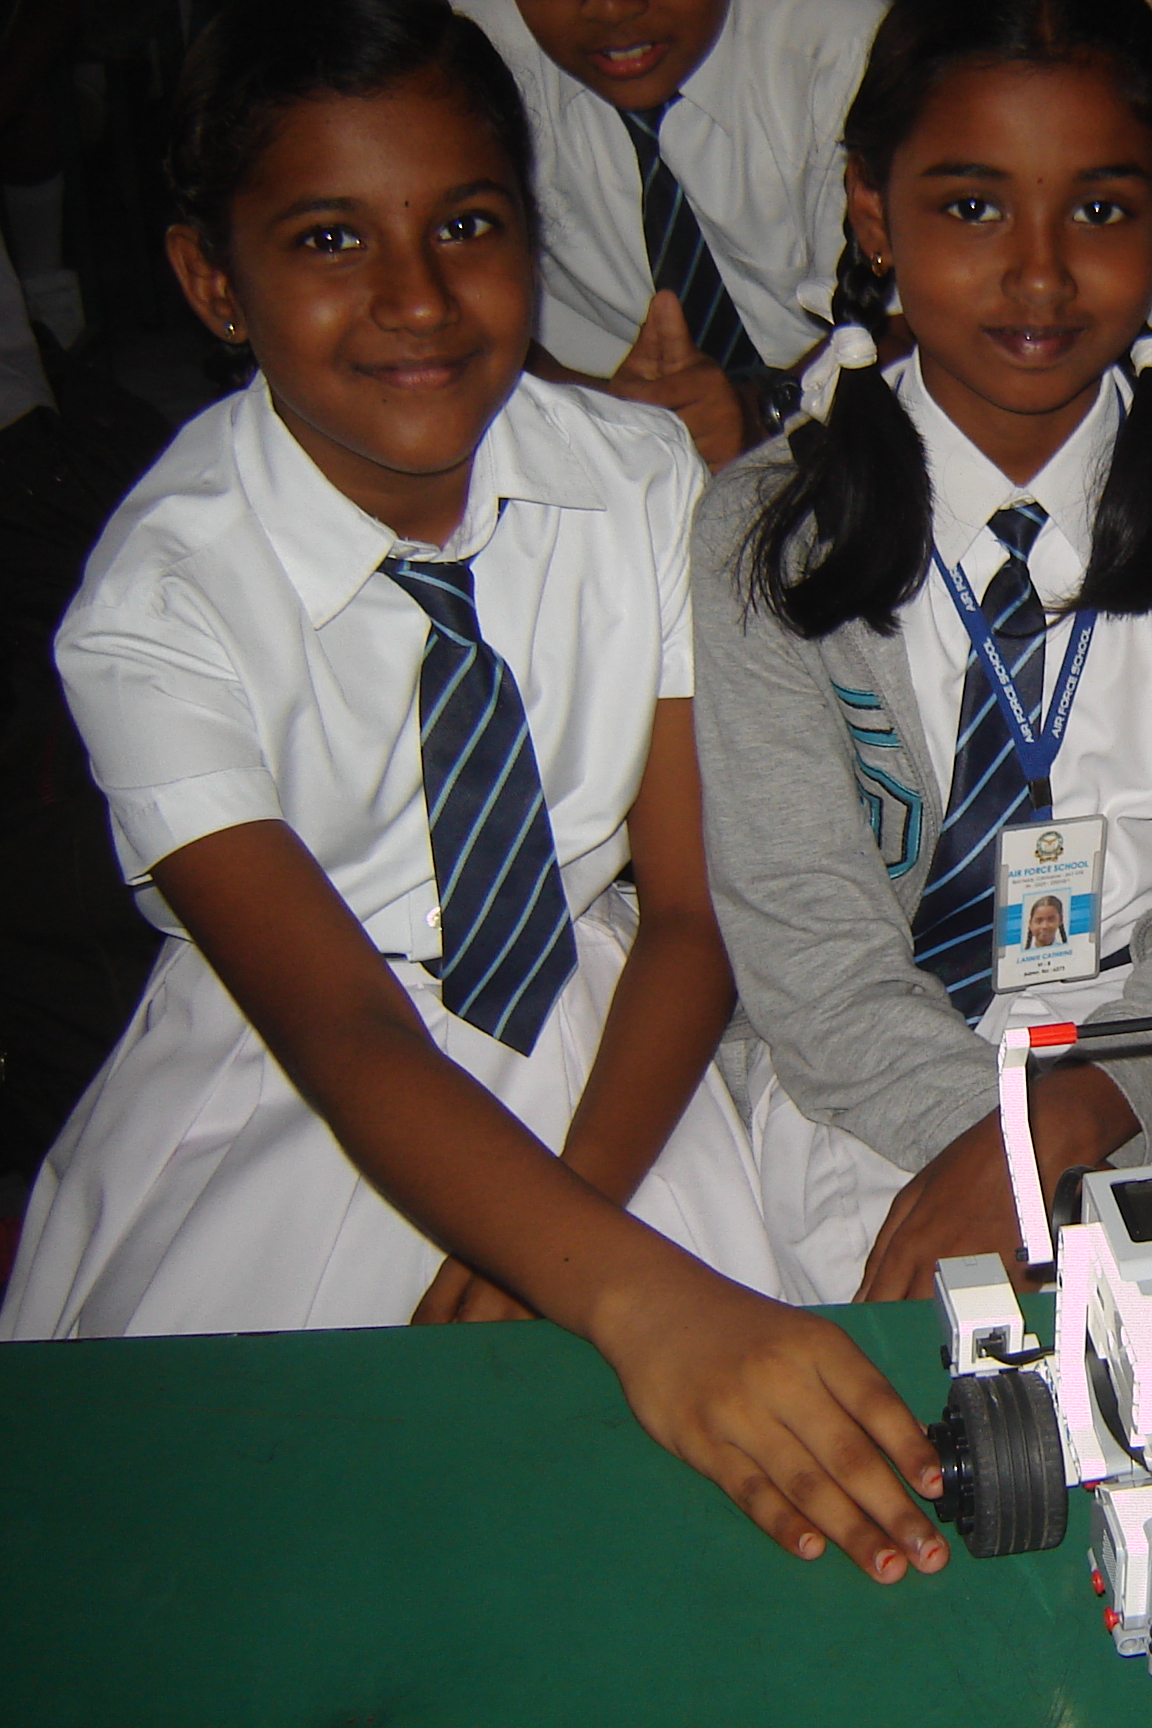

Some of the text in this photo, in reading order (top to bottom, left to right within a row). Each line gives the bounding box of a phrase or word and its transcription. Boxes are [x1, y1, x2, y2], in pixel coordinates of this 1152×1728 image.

[960, 591, 976, 611] AIR
[983, 637, 1035, 744] AIR FORCE SCHOOL
[1051, 627, 1092, 740] AIR FORCE SCHOOL
[1008, 869, 1021, 878] AIR
[1024, 865, 1052, 877] FORCE
[1053, 861, 1089, 872] SCHOOL
